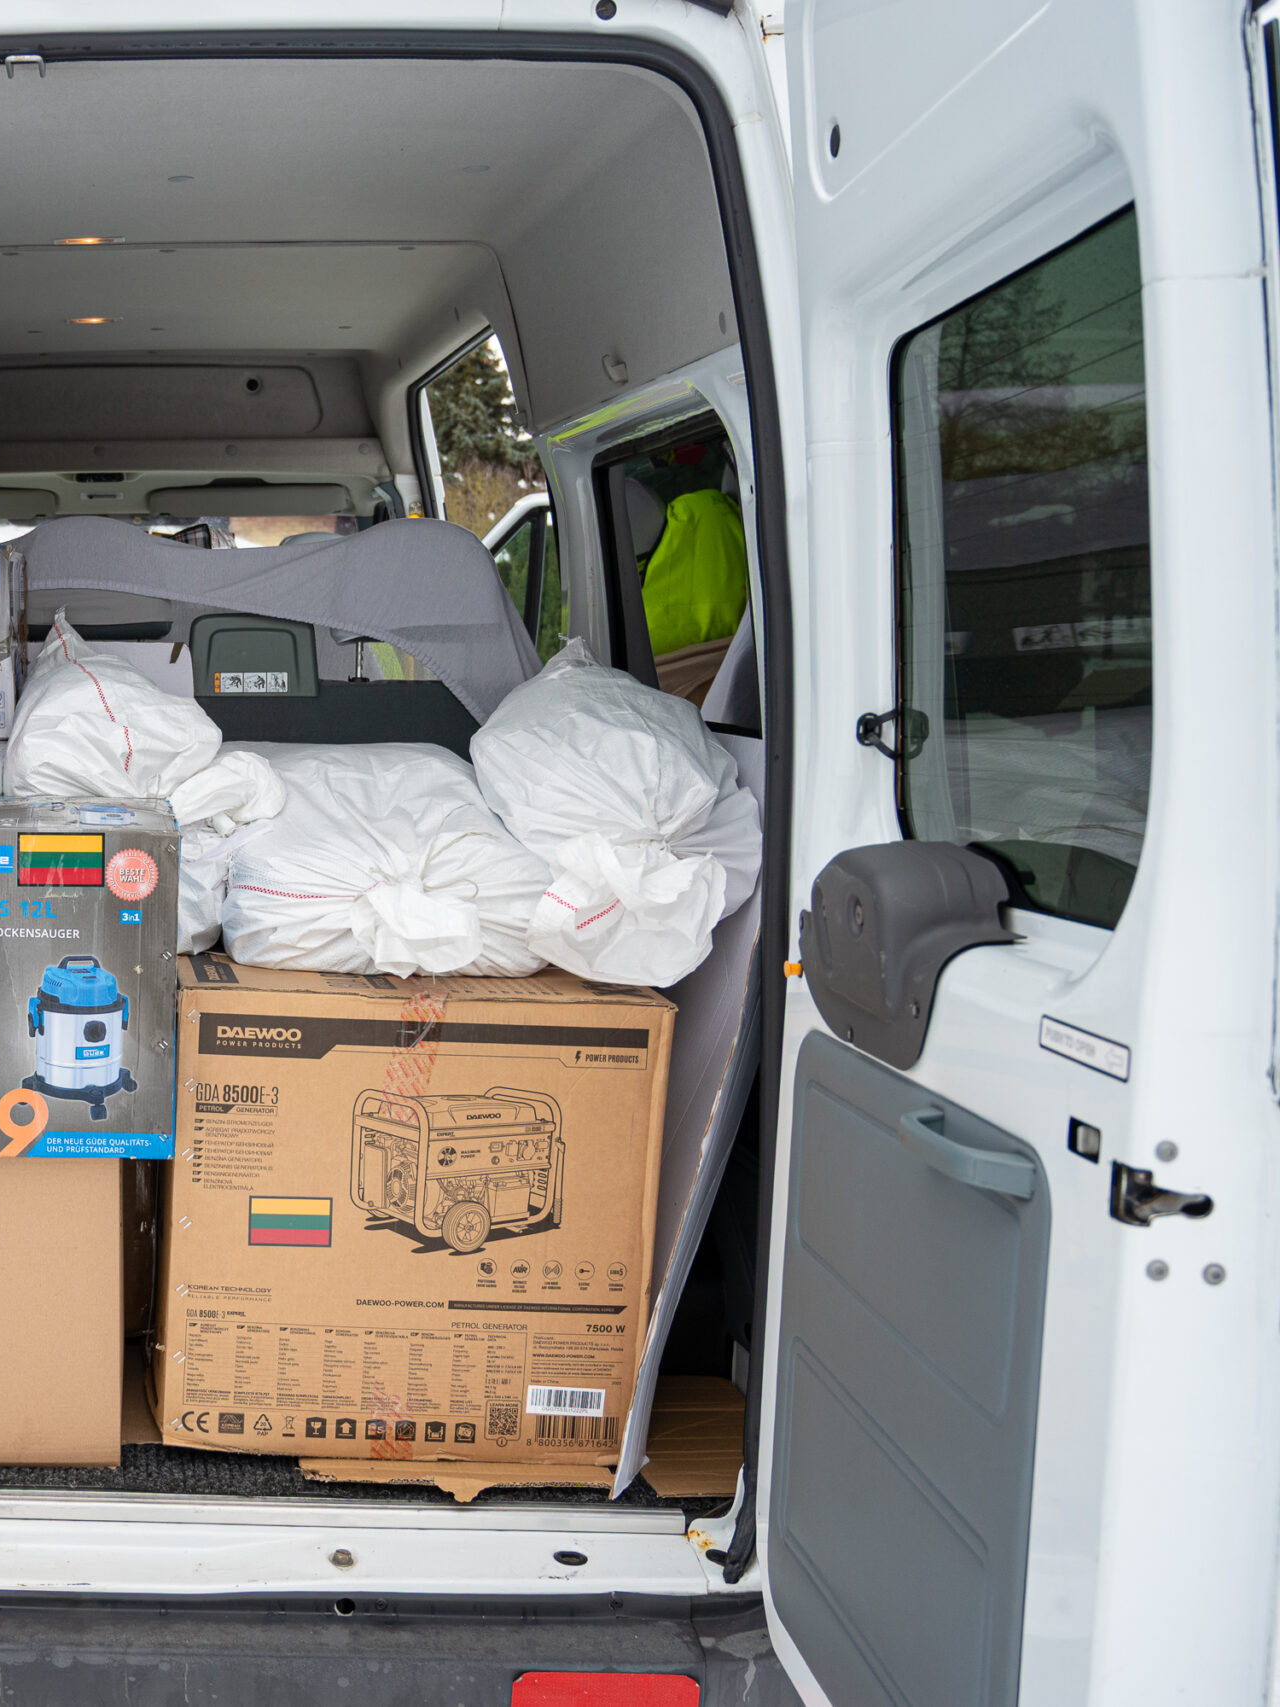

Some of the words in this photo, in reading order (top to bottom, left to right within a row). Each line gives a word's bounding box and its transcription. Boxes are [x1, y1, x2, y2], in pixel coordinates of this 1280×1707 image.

[120, 868, 145, 876] BESTE
[120, 875, 145, 883] WAHL
[20, 900, 57, 918] 12L
[122, 912, 140, 921] 3in1
[217, 1026, 302, 1041] DAEWOO
[585, 1054, 606, 1062] POWER
[608, 1054, 639, 1064] PRODUCTS
[196, 1083, 219, 1102] GDA
[223, 1084, 279, 1104] 8500E-3
[86, 1137, 107, 1146] GÜDE
[109, 1138, 152, 1147] QUALITÄTS-
[356, 1299, 444, 1308] DAEWOO-POWER.COM
[186, 1309, 198, 1317] GDA
[586, 1324, 612, 1333] 7500
[616, 1325, 626, 1333] W
[538, 1439, 574, 1447] 800356
[579, 1440, 613, 1448] 871642
